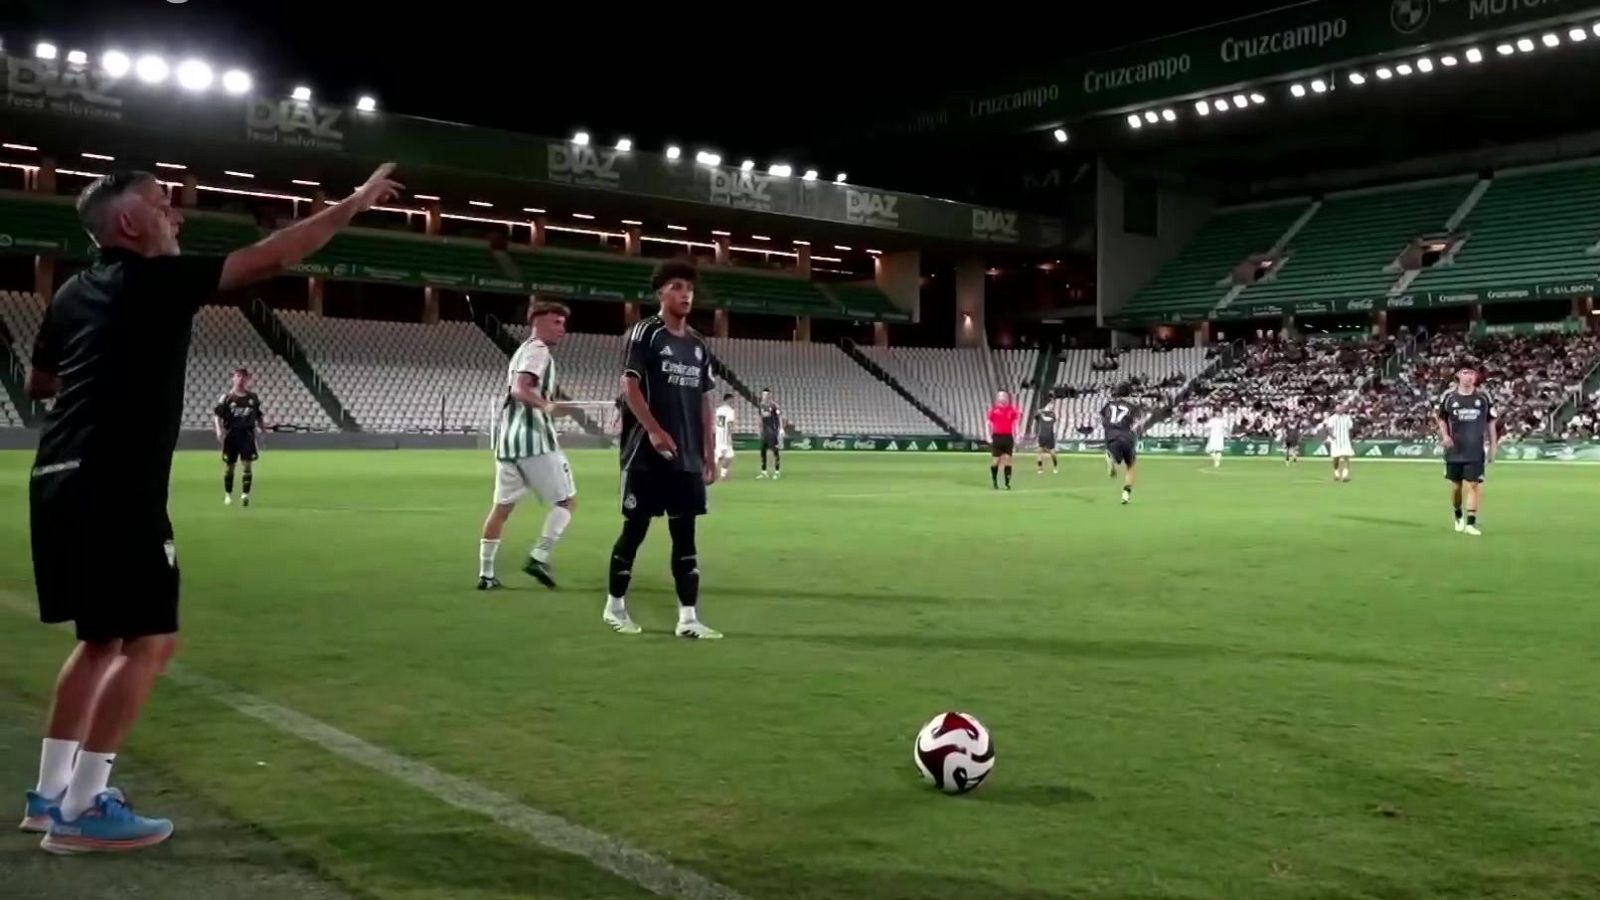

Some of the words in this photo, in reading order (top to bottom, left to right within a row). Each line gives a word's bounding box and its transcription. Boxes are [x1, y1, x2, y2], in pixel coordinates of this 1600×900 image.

[1220, 17, 1348, 63] Cruzcampo
[1083, 52, 1191, 94] Cruzcampo
[968, 83, 1059, 119] Cruzcampo
[247, 98, 344, 140] DIAZ
[547, 144, 620, 178] DIAZ
[710, 168, 771, 201] DIAZ
[846, 190, 899, 218] DIAZ
[972, 208, 1018, 235] DIAZ
[1110, 405, 1129, 424] 17
